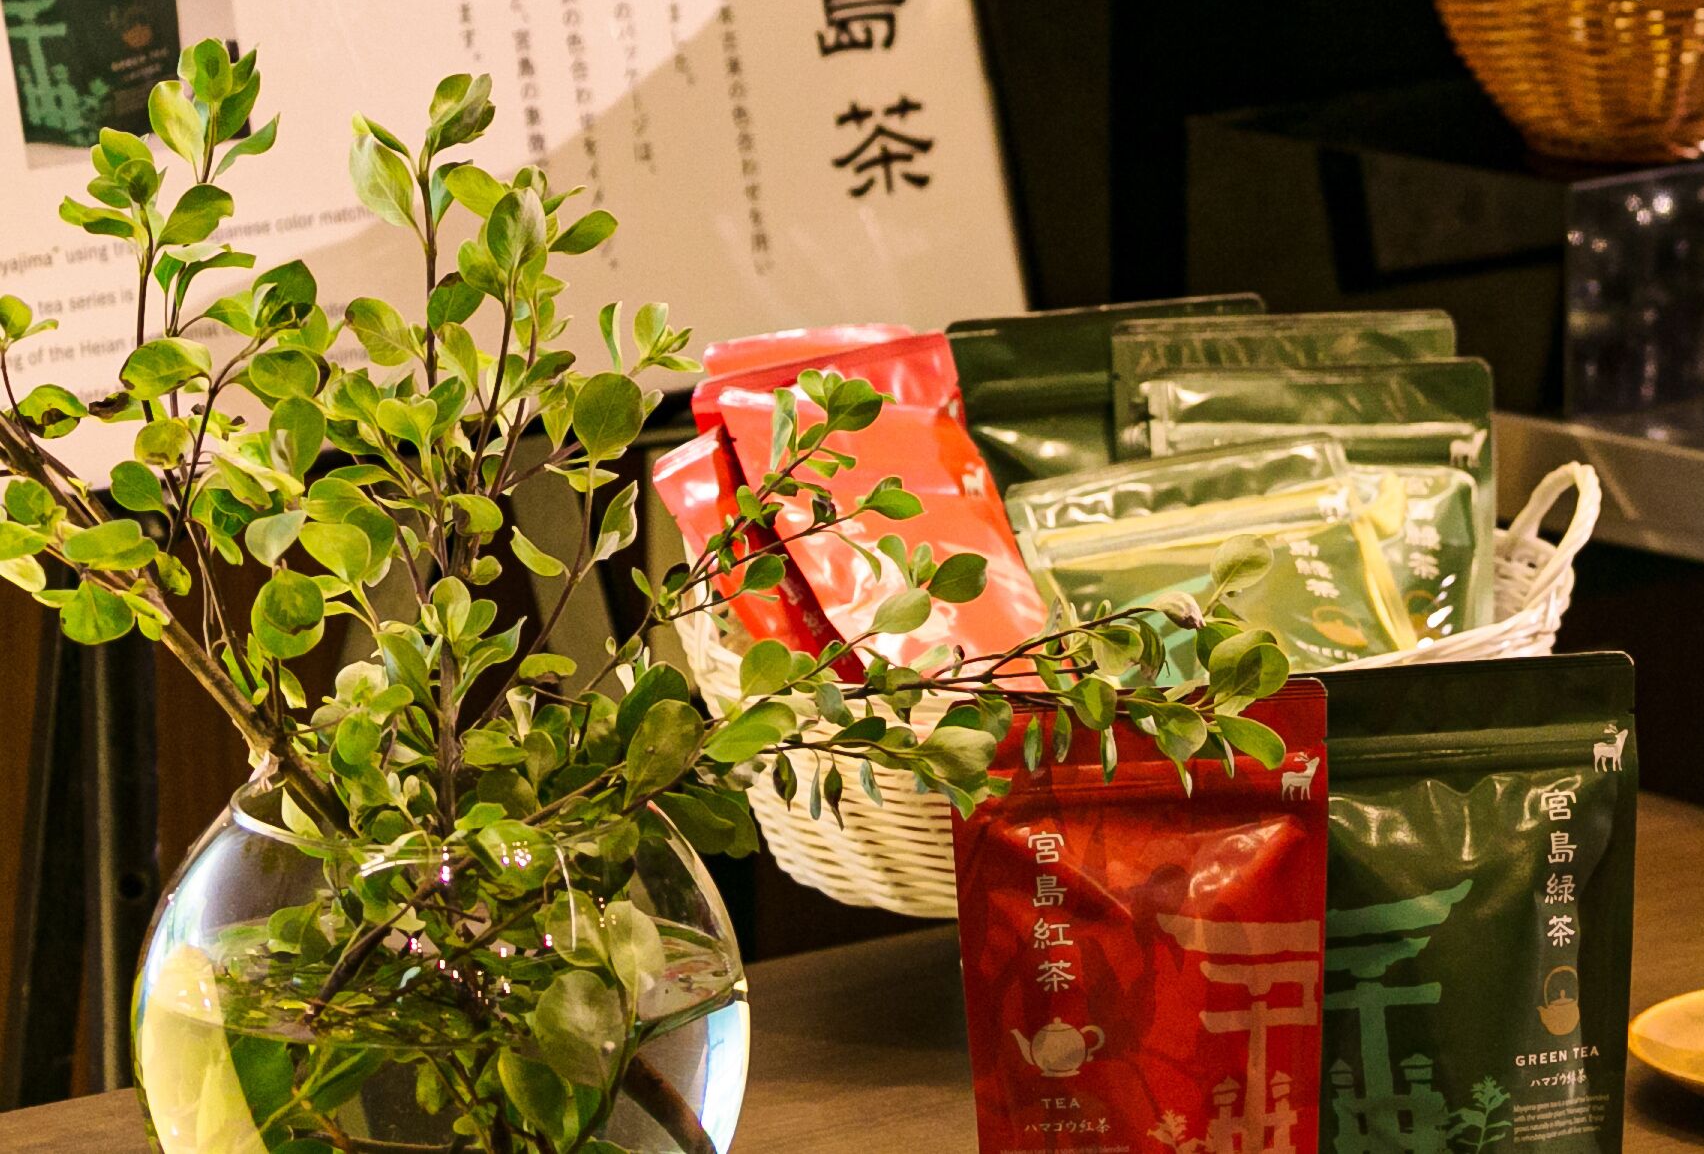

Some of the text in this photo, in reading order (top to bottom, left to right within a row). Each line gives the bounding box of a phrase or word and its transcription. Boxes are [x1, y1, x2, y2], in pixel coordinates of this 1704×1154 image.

[1540, 789, 1577, 948] 宮島緑茶
[1027, 831, 1076, 992] 宮島紅茶
[1515, 1046, 1599, 1067] GREEN TEA
[1041, 1097, 1081, 1110] TEA
[1024, 1117, 1111, 1134] ハマゴウ紅茶
